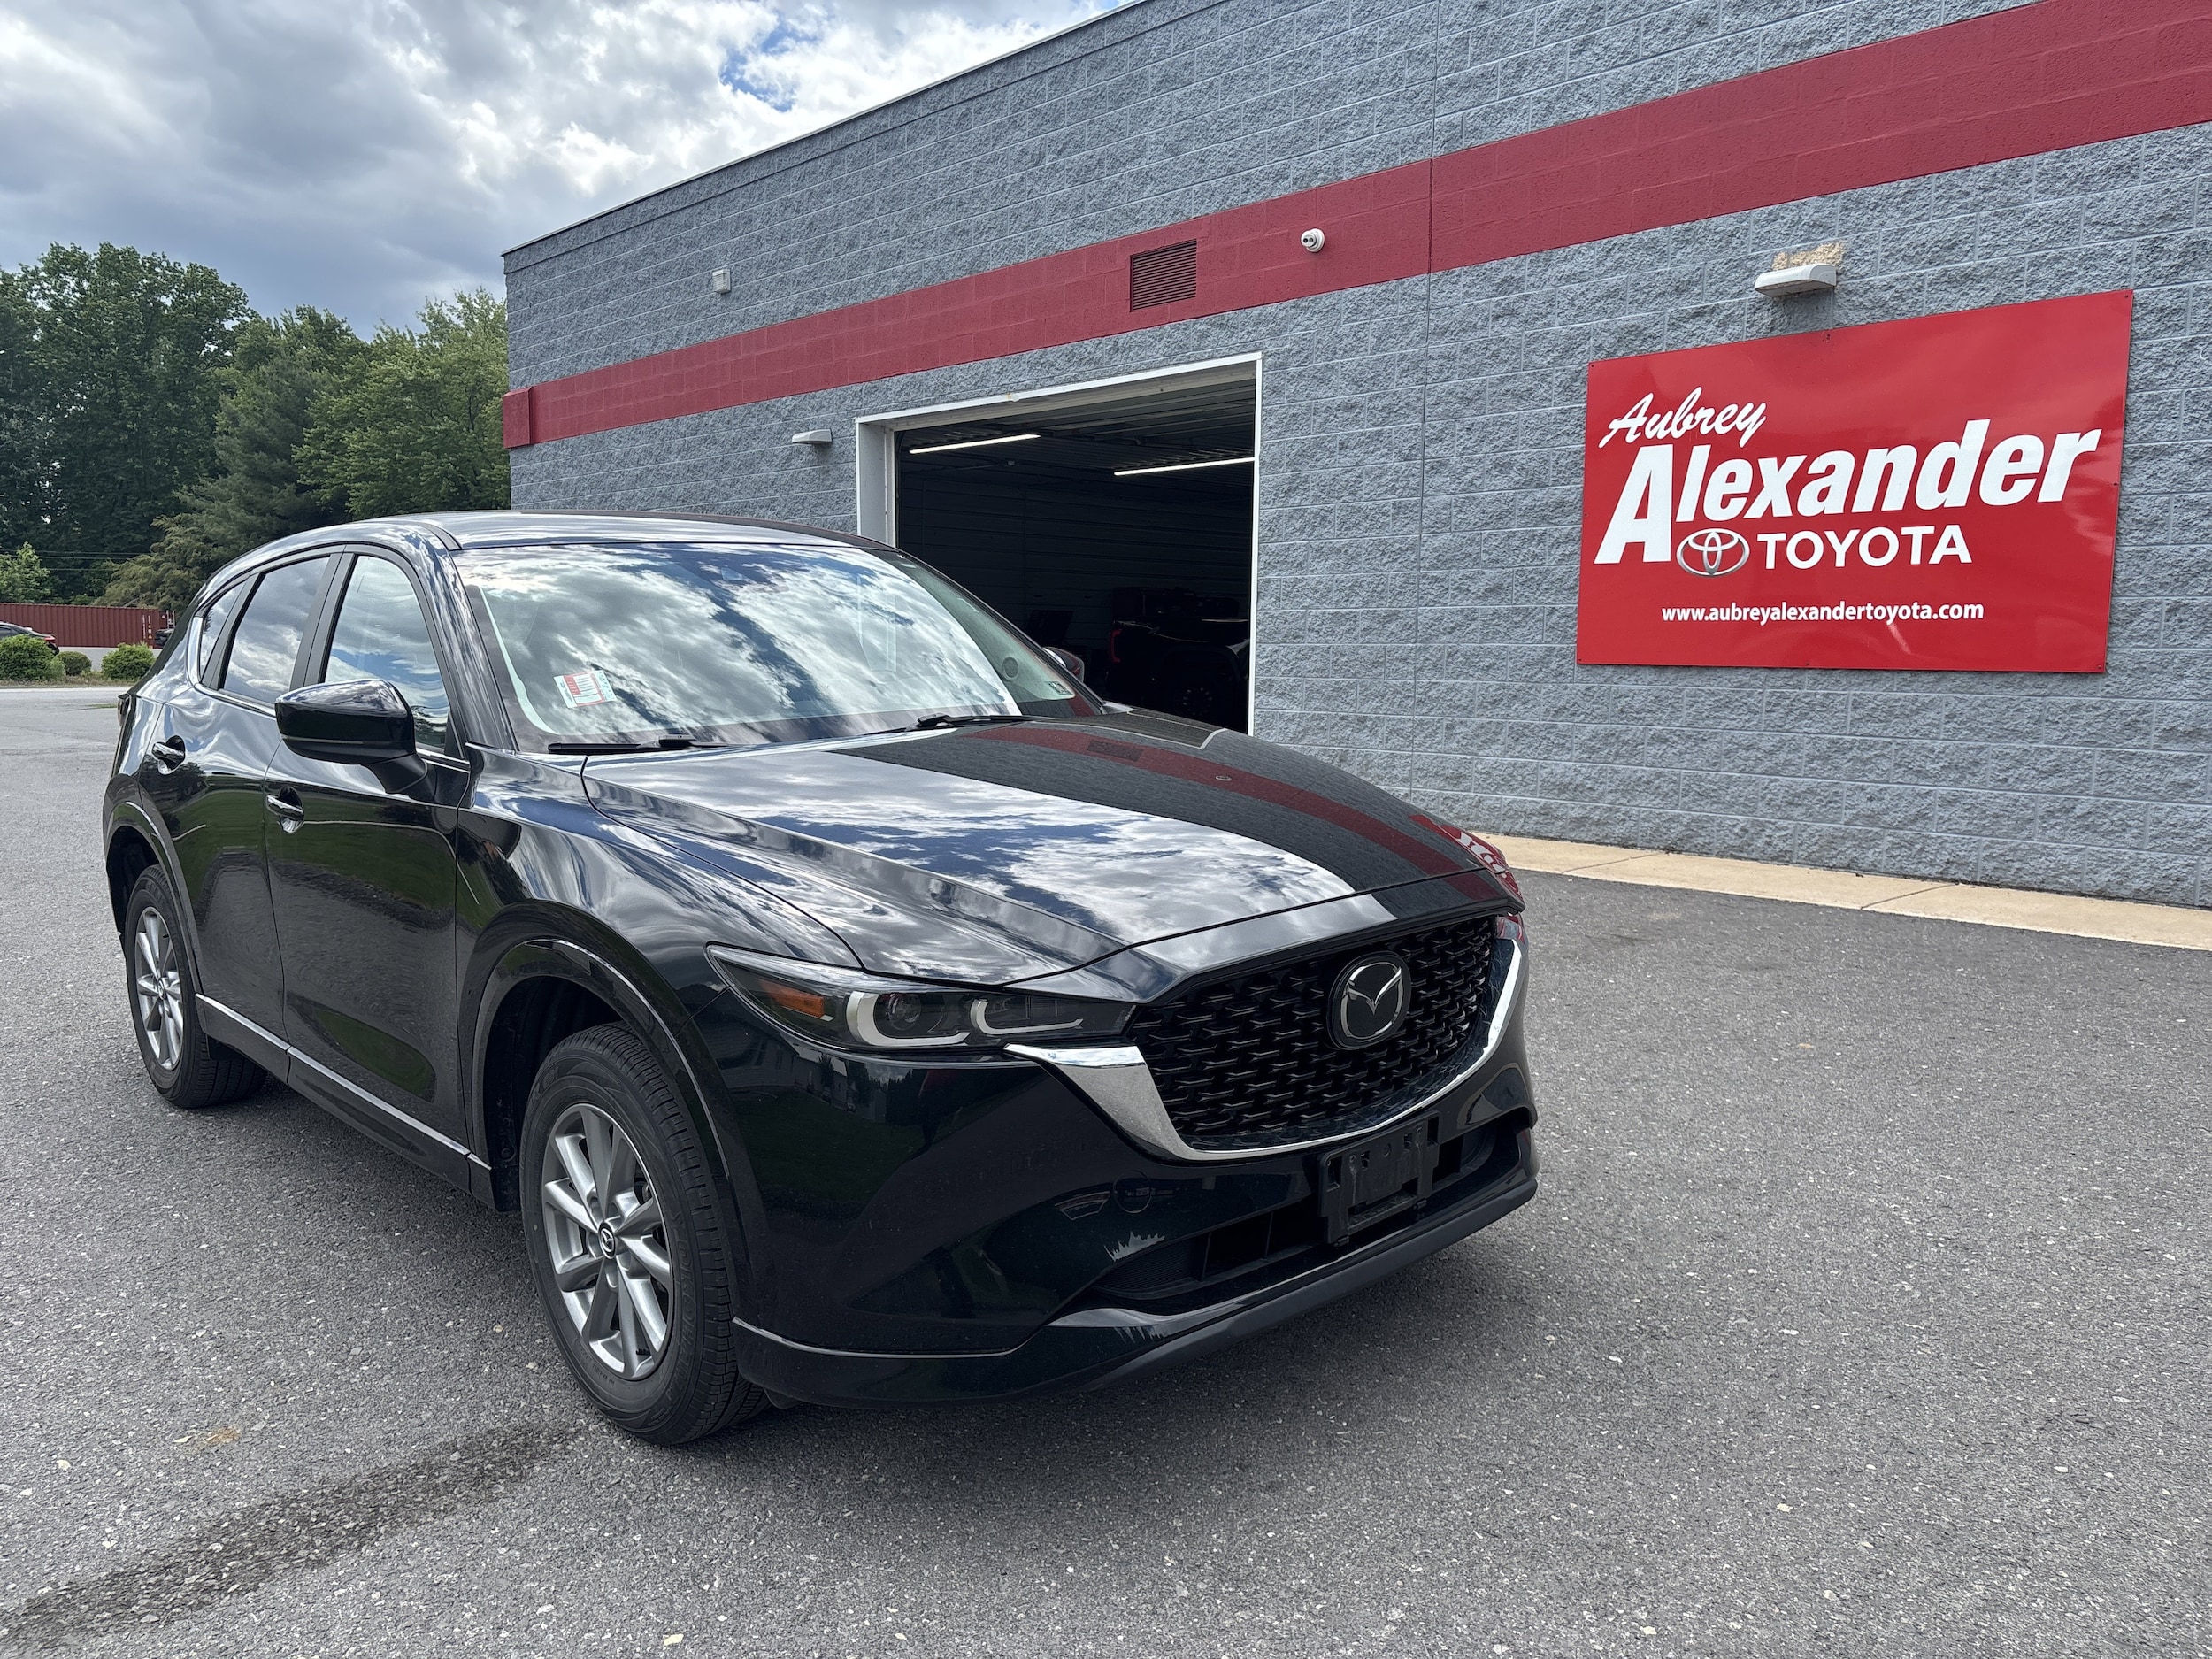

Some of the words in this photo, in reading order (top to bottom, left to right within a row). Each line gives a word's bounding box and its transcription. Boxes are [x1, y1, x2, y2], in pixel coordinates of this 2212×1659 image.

[1599, 387, 1766, 448] Aubrey
[1594, 419, 2101, 564] Alexander
[1757, 525, 1971, 569] TOYOTA
[1663, 601, 1985, 626] www.aubreyalexandertoyota.com
